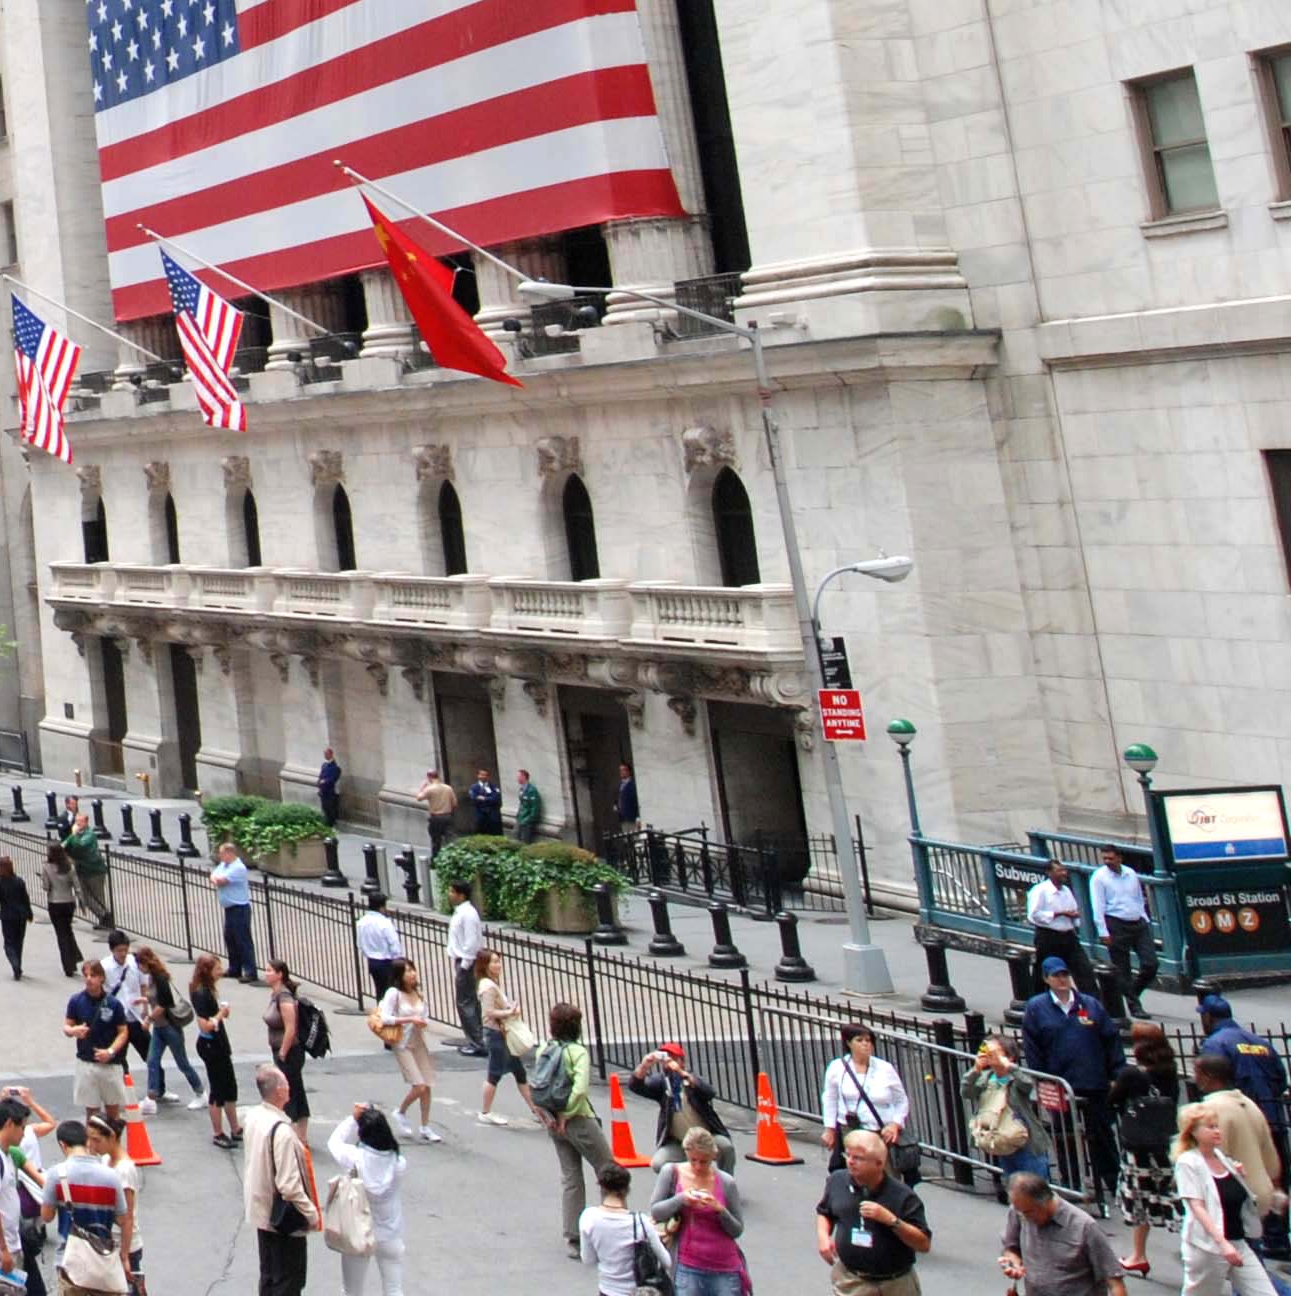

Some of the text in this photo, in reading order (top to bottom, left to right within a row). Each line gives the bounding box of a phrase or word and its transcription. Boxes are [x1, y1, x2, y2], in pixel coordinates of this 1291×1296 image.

[832, 695, 848, 705] NO
[822, 708, 861, 717] STANDING
[826, 719, 861, 728] ANYTIME
[994, 863, 1045, 883] Subway
[1186, 891, 1280, 907] Broad St Station
